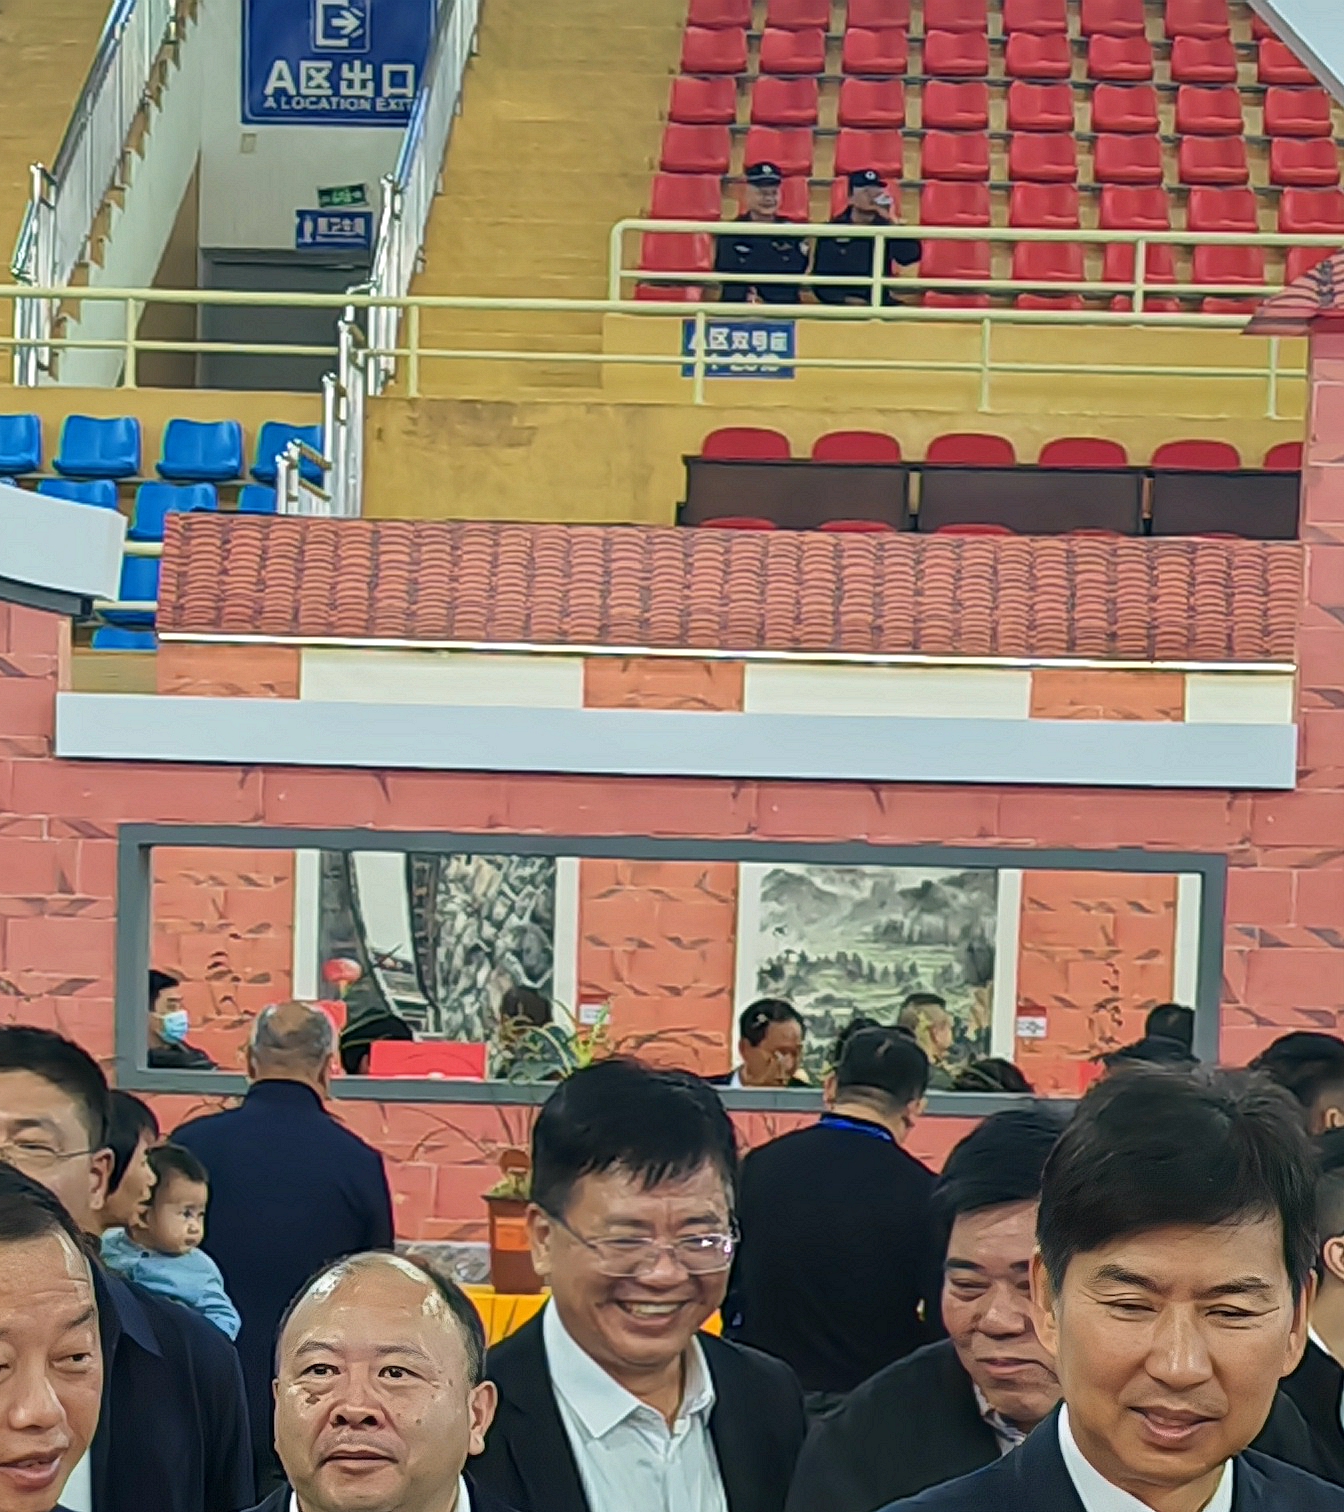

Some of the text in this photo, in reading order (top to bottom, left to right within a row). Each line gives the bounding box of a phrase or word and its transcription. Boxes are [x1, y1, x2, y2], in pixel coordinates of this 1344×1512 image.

[263, 59, 416, 98] A区出口
[263, 97, 415, 112] A LOCATION EXIT
